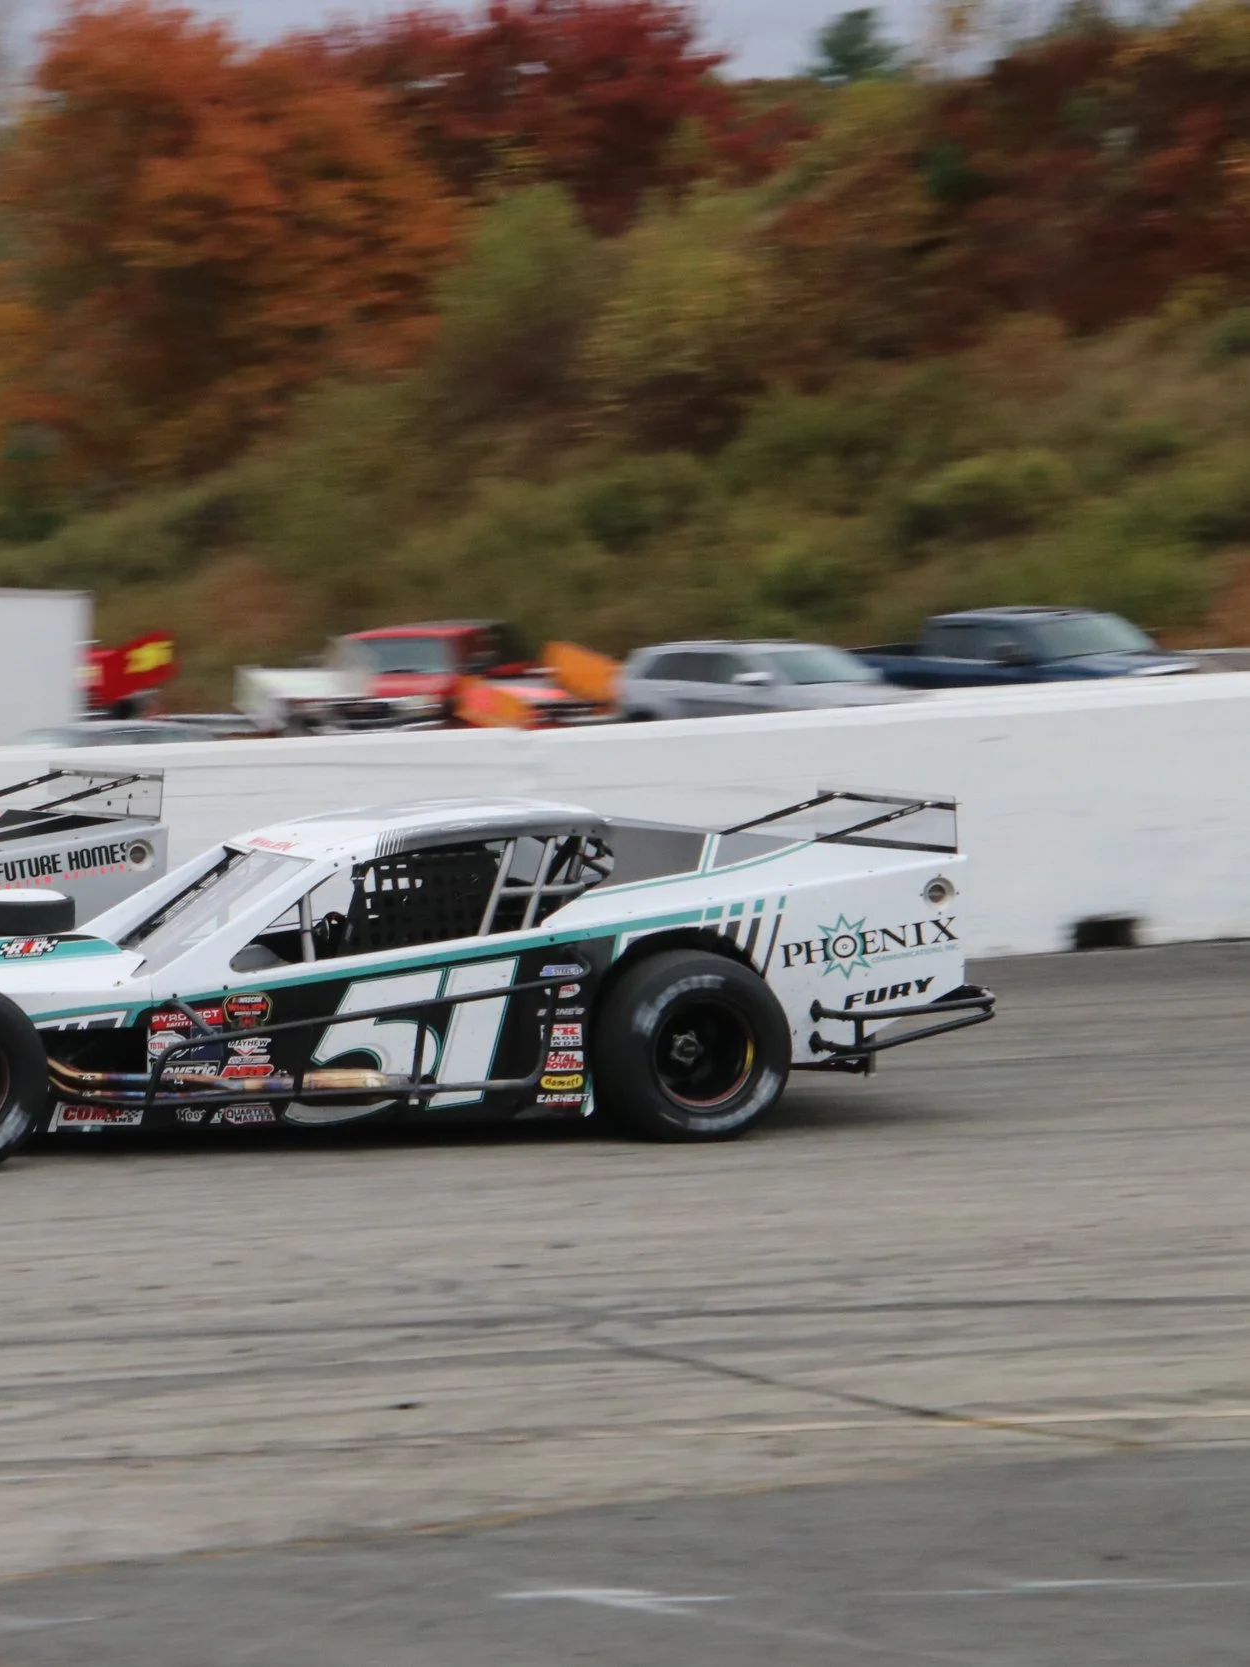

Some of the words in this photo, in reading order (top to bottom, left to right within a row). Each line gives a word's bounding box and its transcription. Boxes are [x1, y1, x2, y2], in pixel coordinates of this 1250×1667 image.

[67, 843, 126, 871] HOMES
[780, 916, 959, 968] PHOENIX
[844, 976, 936, 1010] FURY
[229, 1039, 269, 1048] MAYHEW
[282, 955, 519, 1126] 51
[164, 1065, 218, 1078] OMETIC
[536, 1093, 590, 1103] EARNEST
[62, 1106, 123, 1122] COMP
[103, 1114, 134, 1124] CAMS
[234, 1114, 276, 1123] MASTER
